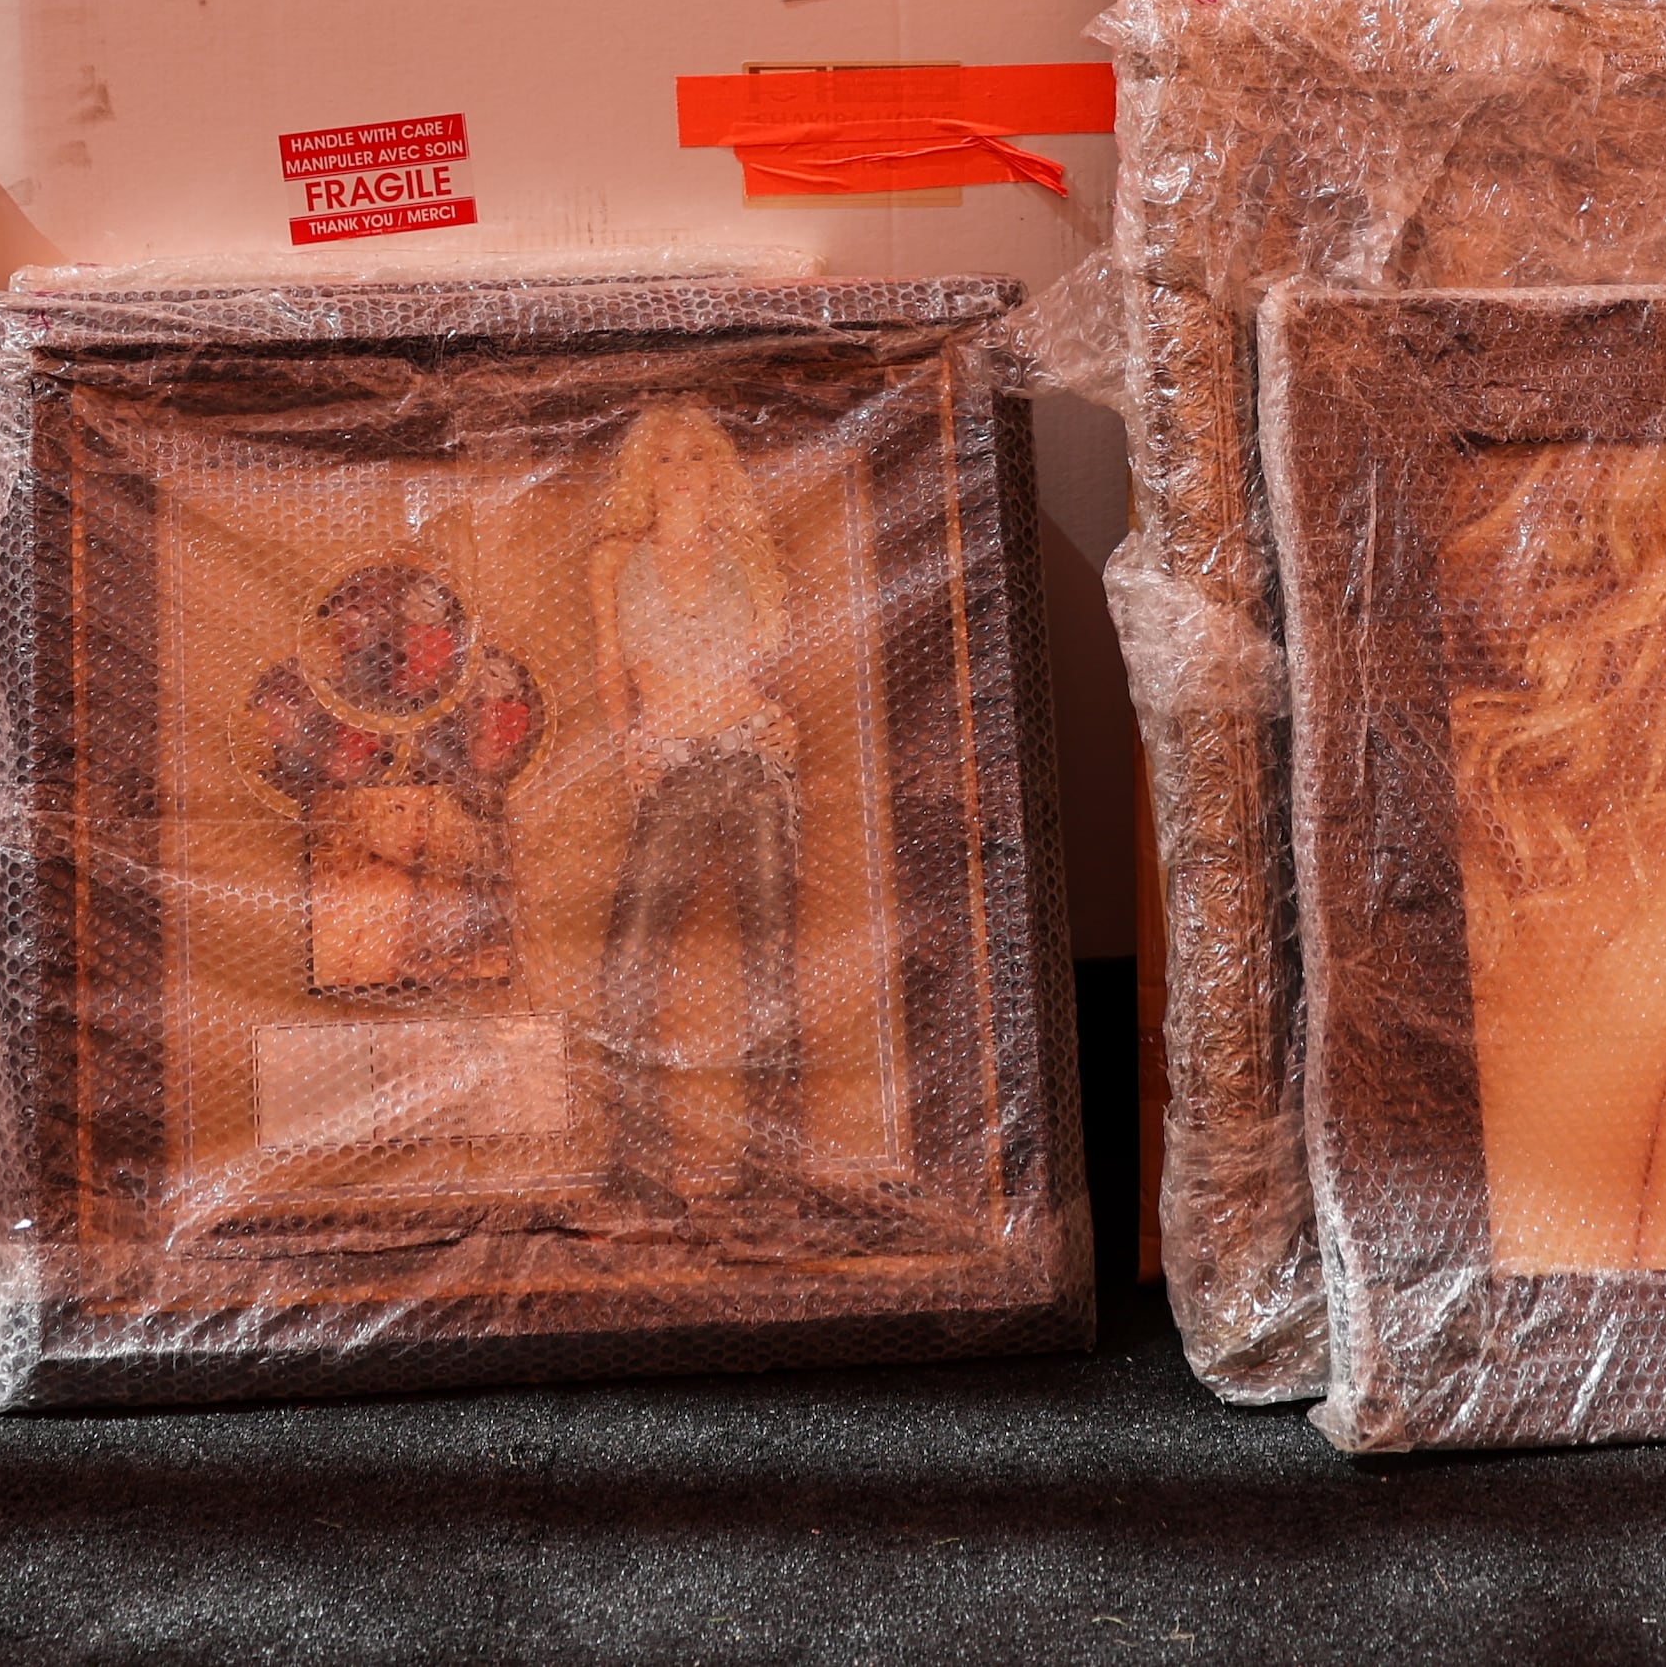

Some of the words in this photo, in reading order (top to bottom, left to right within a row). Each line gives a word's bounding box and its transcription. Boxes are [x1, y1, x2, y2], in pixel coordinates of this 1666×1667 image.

[290, 132, 354, 153] HANDLE
[358, 127, 397, 144] WITH
[401, 121, 444, 139] CARE
[286, 150, 373, 175] MANIPULER
[378, 145, 421, 163] AVEC
[425, 140, 464, 157] SOIN
[305, 166, 452, 212] FRAGILE
[308, 217, 360, 236] THANK
[361, 212, 394, 230] YOU
[407, 205, 456, 224] MERCI
